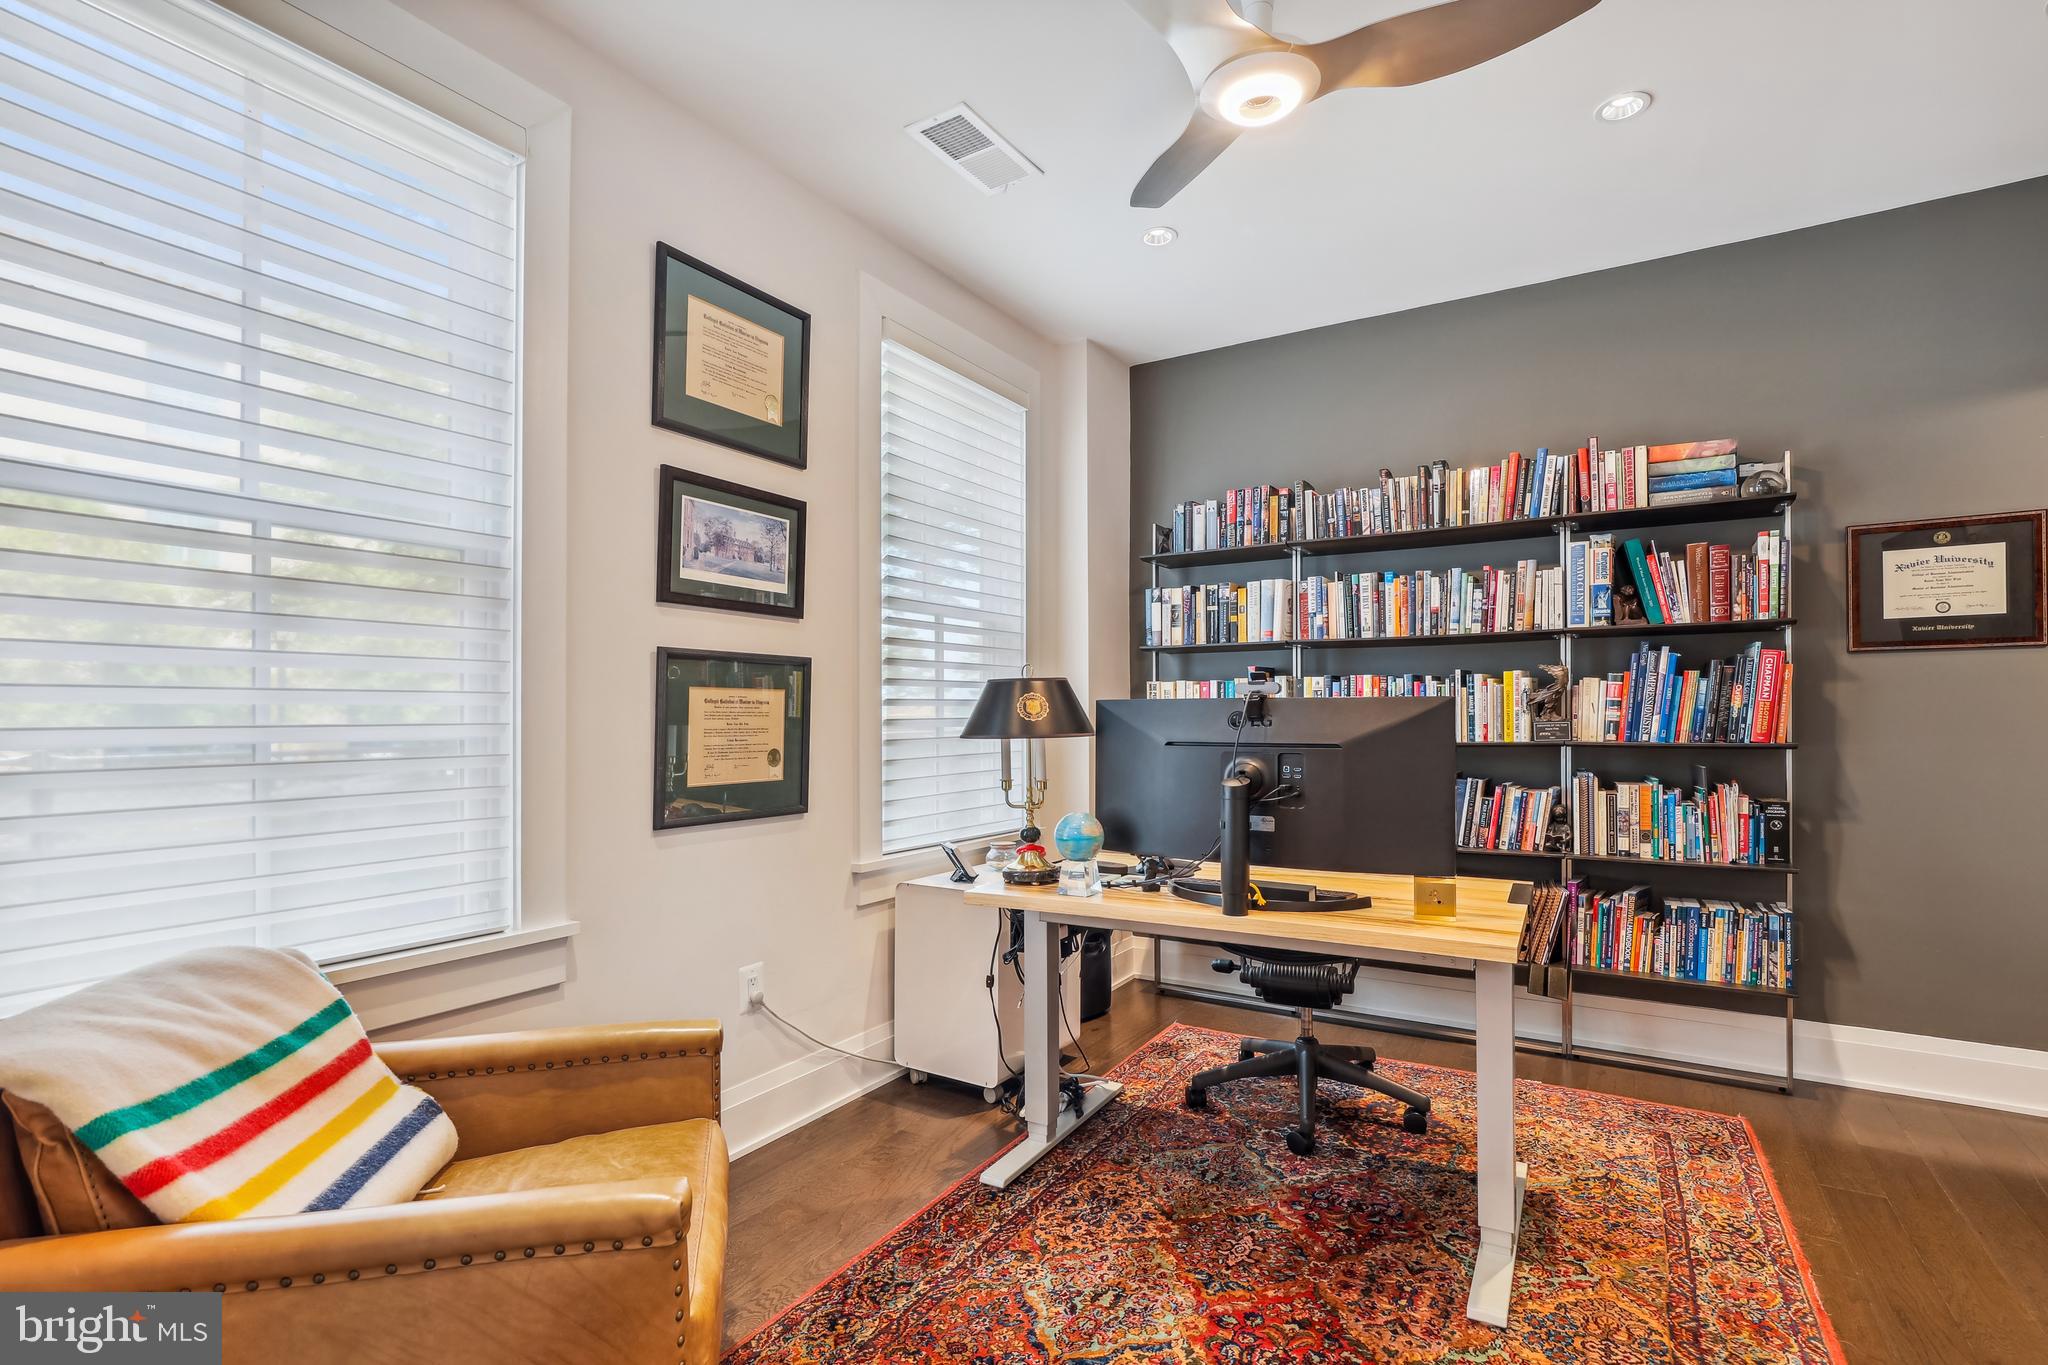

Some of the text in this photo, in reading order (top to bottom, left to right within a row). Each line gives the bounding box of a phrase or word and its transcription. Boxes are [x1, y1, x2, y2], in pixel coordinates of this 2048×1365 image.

[1894, 555, 1995, 573] Xavier University
[1911, 622, 1975, 632] Xavier University
[1761, 657, 1774, 699] CHAPMAN
[1642, 671, 1658, 734] IMPRESSIONISTS
[1743, 687, 1751, 704] GUIDE
[1761, 702, 1770, 729] PILOTING
[1624, 896, 1636, 961] SURVIVAL HANDBOOK
